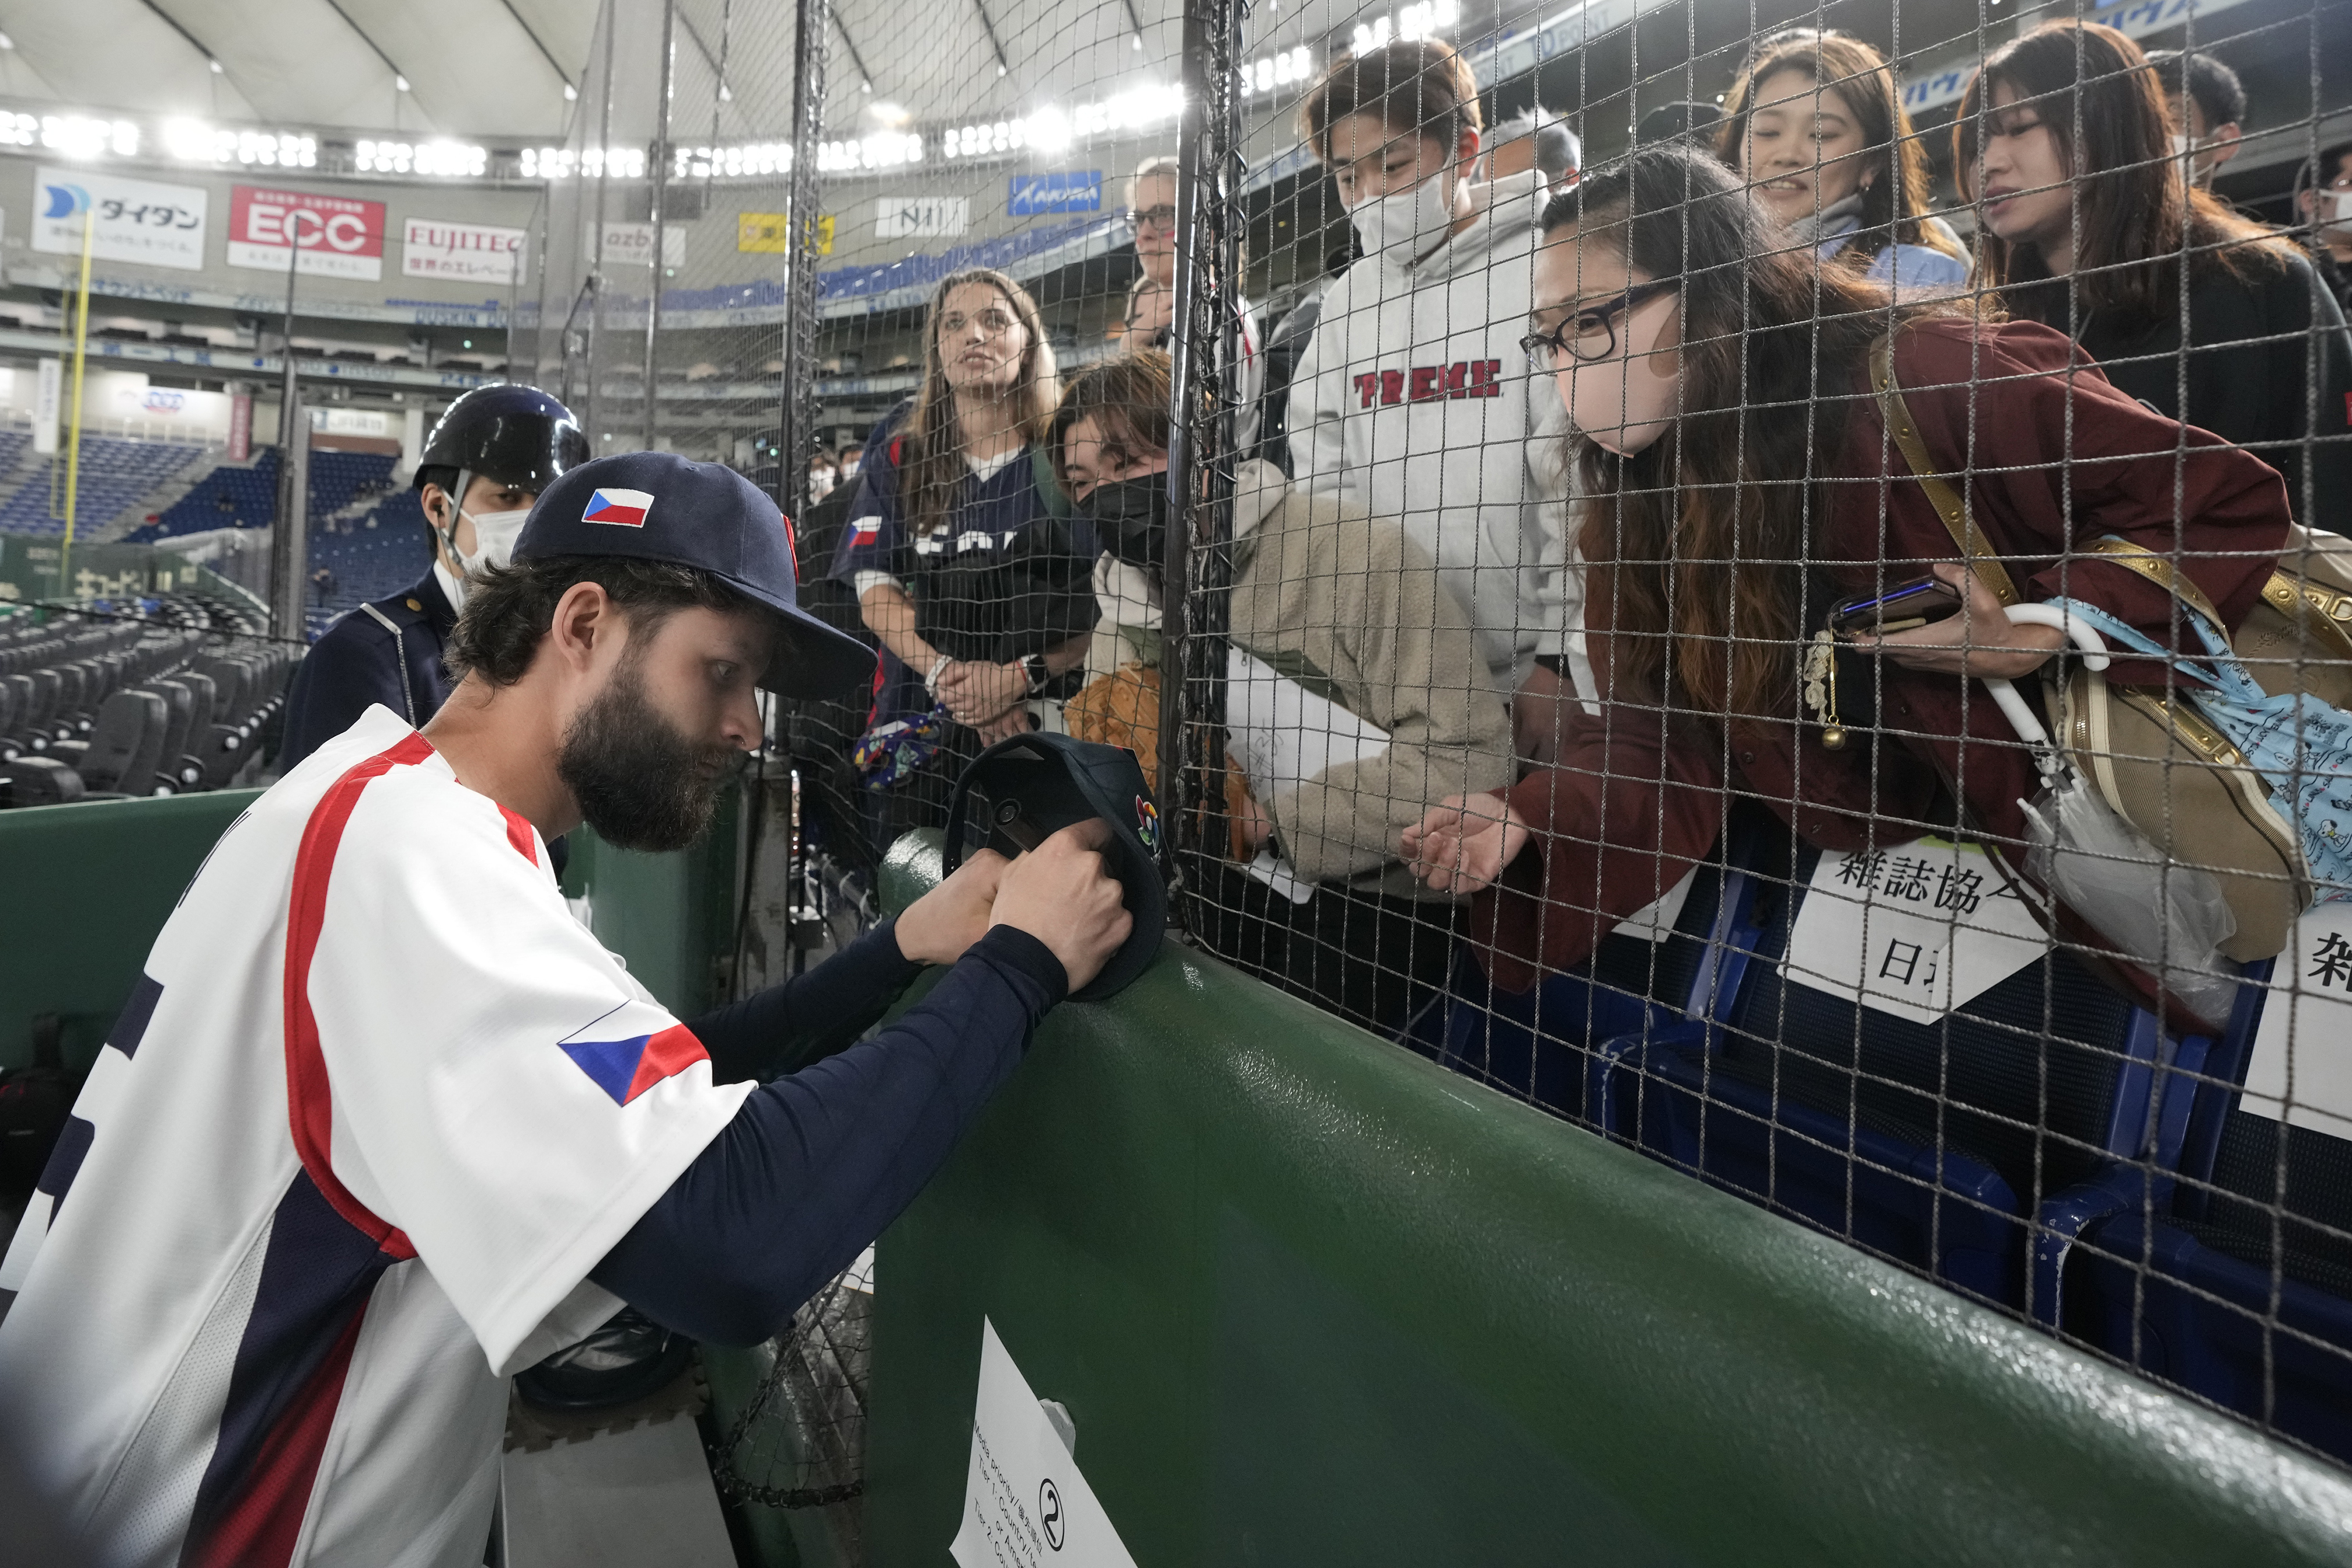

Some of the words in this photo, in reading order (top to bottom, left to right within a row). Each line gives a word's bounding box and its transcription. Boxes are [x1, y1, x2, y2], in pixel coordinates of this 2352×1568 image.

[1904, 73, 1960, 106] ハウ
[247, 203, 368, 252] ECC
[410, 227, 521, 254] FUJITEC
[410, 258, 517, 276] 世界のエレベー
[1353, 359, 1501, 408] PREME
[974, 1420, 990, 1459] Media
[979, 1454, 990, 1483] Tier
[974, 1497, 986, 1527] Tier
[996, 1520, 1003, 1534] or
